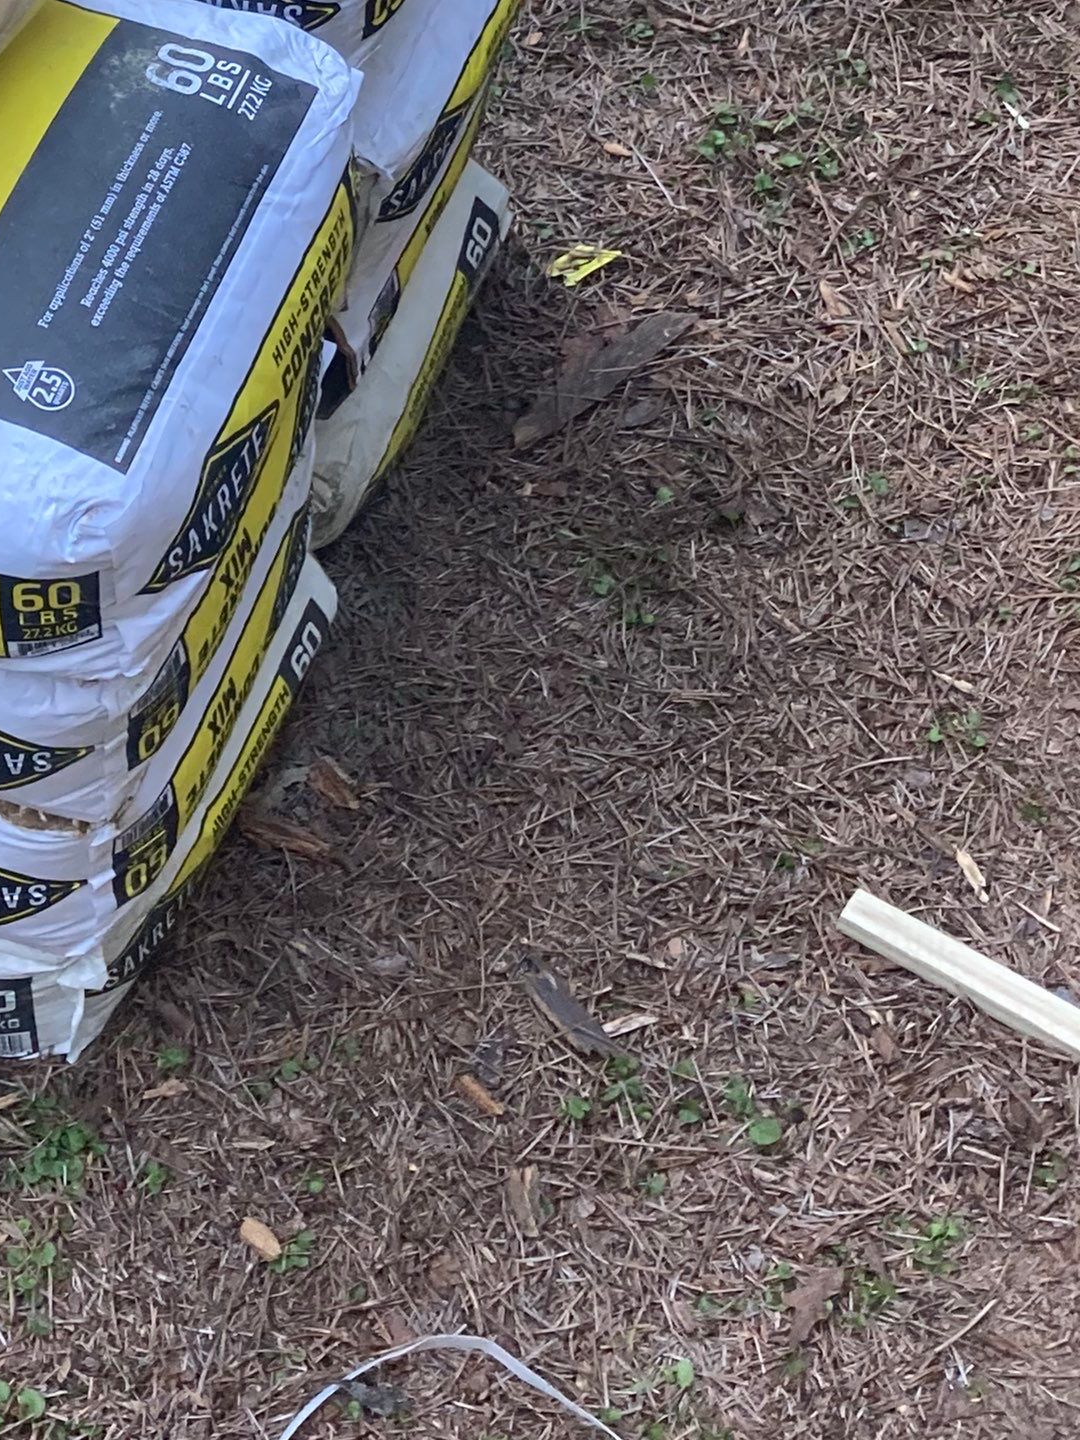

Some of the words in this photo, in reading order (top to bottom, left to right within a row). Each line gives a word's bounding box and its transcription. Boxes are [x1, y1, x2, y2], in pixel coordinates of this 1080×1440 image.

[145, 43, 216, 95] 60
[200, 60, 242, 106] LBS
[250, 74, 273, 97] KG
[145, 108, 163, 133] more.
[237, 92, 264, 120] 27.2
[140, 131, 150, 143] or
[115, 139, 145, 184] thickness
[146, 167, 160, 182] 28
[110, 179, 122, 194] in
[141, 179, 154, 193] in
[159, 164, 181, 194] ASTM
[99, 190, 117, 216] mm)
[121, 190, 150, 232] strength
[155, 191, 167, 204] of
[84, 228, 95, 243] 2"
[90, 211, 106, 232] (51
[124, 201, 162, 264] requirements
[79, 239, 90, 254] of
[114, 228, 130, 248] psi
[464, 217, 494, 270] 60
[100, 242, 120, 270] 4000
[114, 258, 130, 280] the
[48, 249, 86, 316] applications
[79, 264, 108, 311] Reaches
[272, 208, 345, 368] HIGH-STRENGTH
[37, 306, 53, 332] For
[89, 275, 123, 332] exceeding
[281, 231, 350, 399] CONCRETE
[29, 369, 64, 405] 2.5
[168, 423, 263, 578] SAKRETE
[220, 527, 252, 599] MIX
[12, 581, 82, 612] 60
[18, 608, 79, 626] LBS
[22, 625, 54, 641] 27.2
[55, 620, 78, 636] KG
[291, 621, 322, 682] 60
[207, 676, 237, 745] MIX
[138, 702, 179, 760] 60
[211, 687, 290, 835] HIGH-STRENGTH
[125, 844, 168, 898] 60
